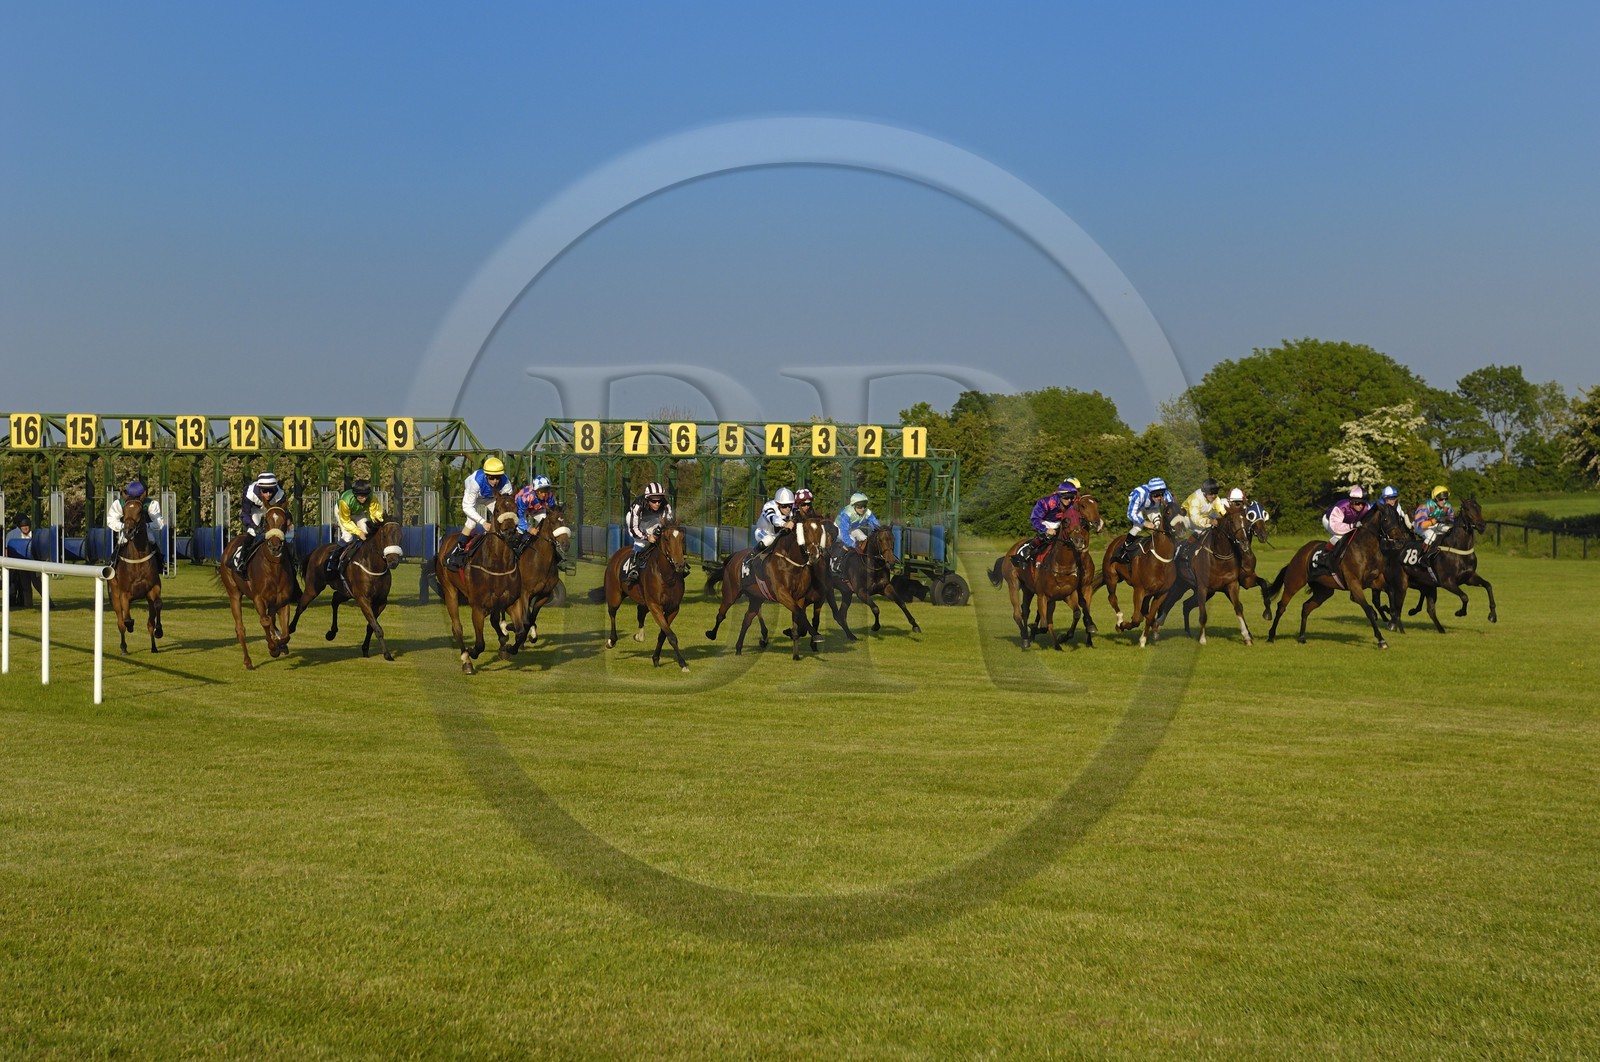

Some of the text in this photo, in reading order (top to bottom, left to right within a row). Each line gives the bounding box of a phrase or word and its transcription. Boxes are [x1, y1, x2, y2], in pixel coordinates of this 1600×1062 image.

[13, 416, 38, 446] 16
[69, 417, 94, 446] 15
[125, 419, 149, 446] 14
[179, 418, 204, 447] 13
[233, 419, 257, 447] 12
[288, 419, 308, 447] 11
[339, 420, 361, 448] 10
[393, 420, 408, 448] 9
[580, 423, 595, 451] 8
[630, 425, 643, 452] 7
[676, 425, 690, 453] 6
[725, 425, 738, 453] 5
[771, 427, 785, 453] 4
[817, 427, 831, 454] 3
[863, 428, 876, 455] 2
[909, 429, 919, 455] 1
[1403, 548, 1418, 565] 18
